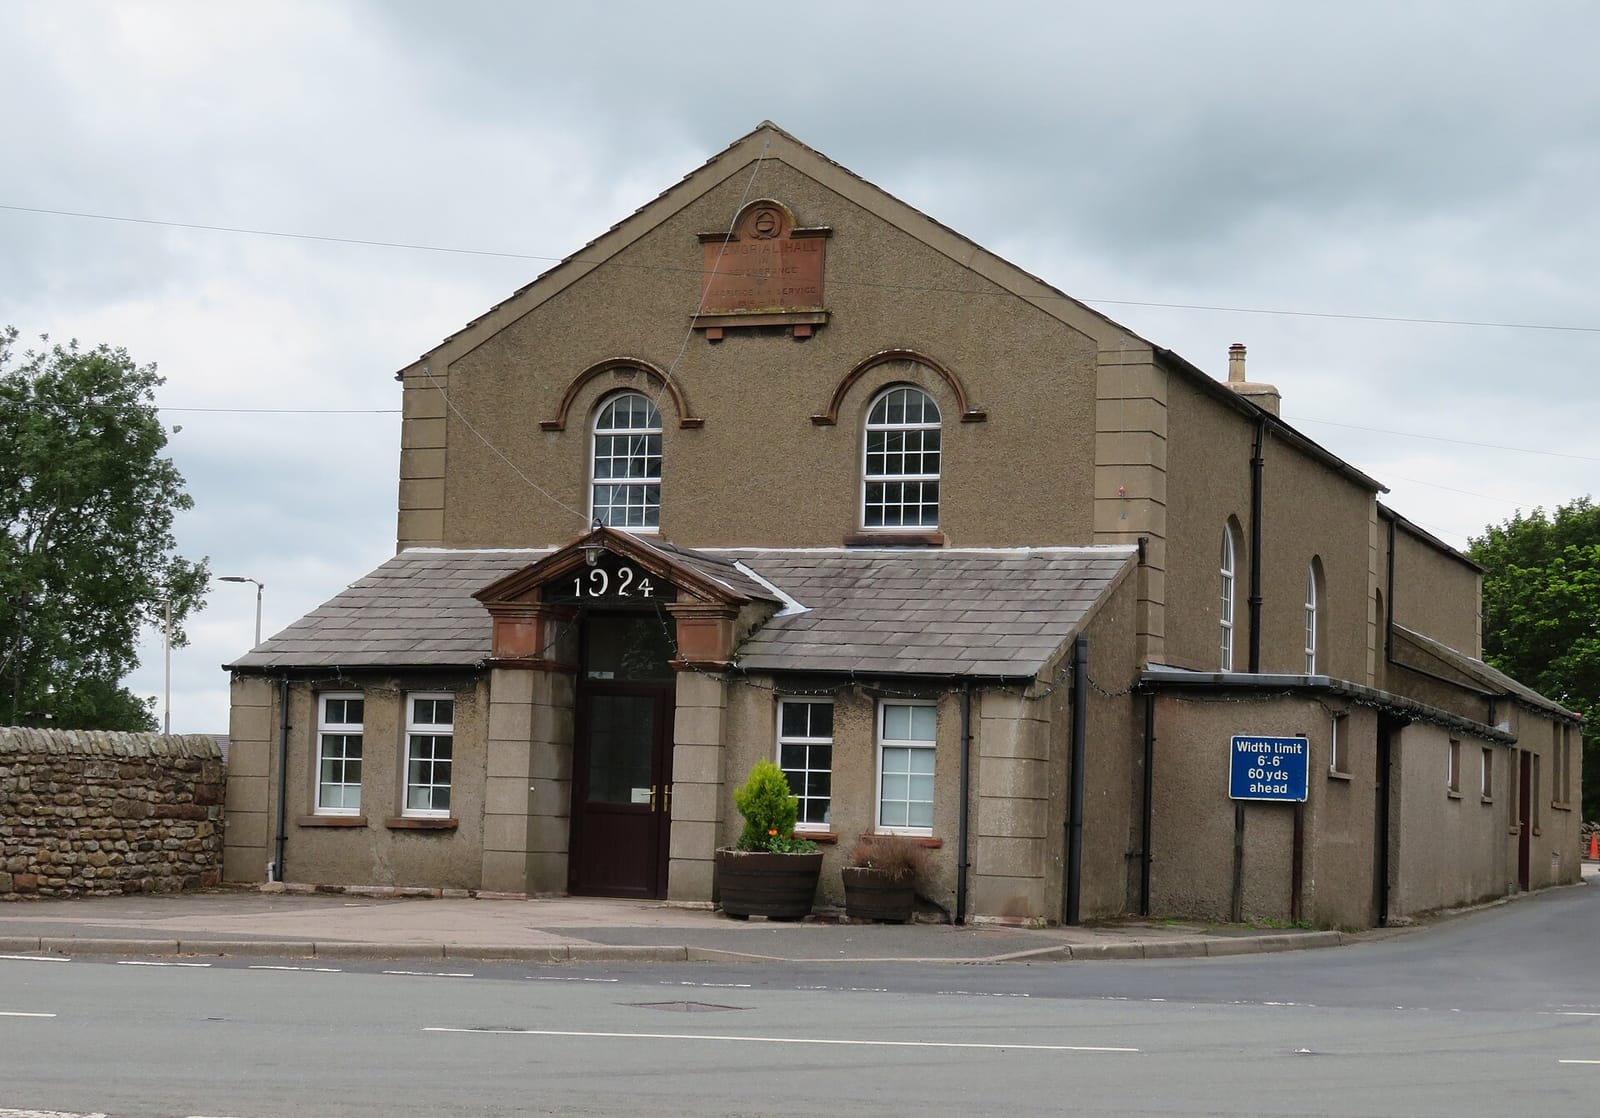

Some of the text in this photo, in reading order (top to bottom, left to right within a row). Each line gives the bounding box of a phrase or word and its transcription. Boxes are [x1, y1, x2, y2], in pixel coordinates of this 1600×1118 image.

[785, 242, 818, 253] HALL
[574, 567, 654, 598] 1924
[1236, 741, 1302, 754] Width limit
[1248, 768, 1288, 782] 60 yds
[1249, 782, 1288, 794] ahead
